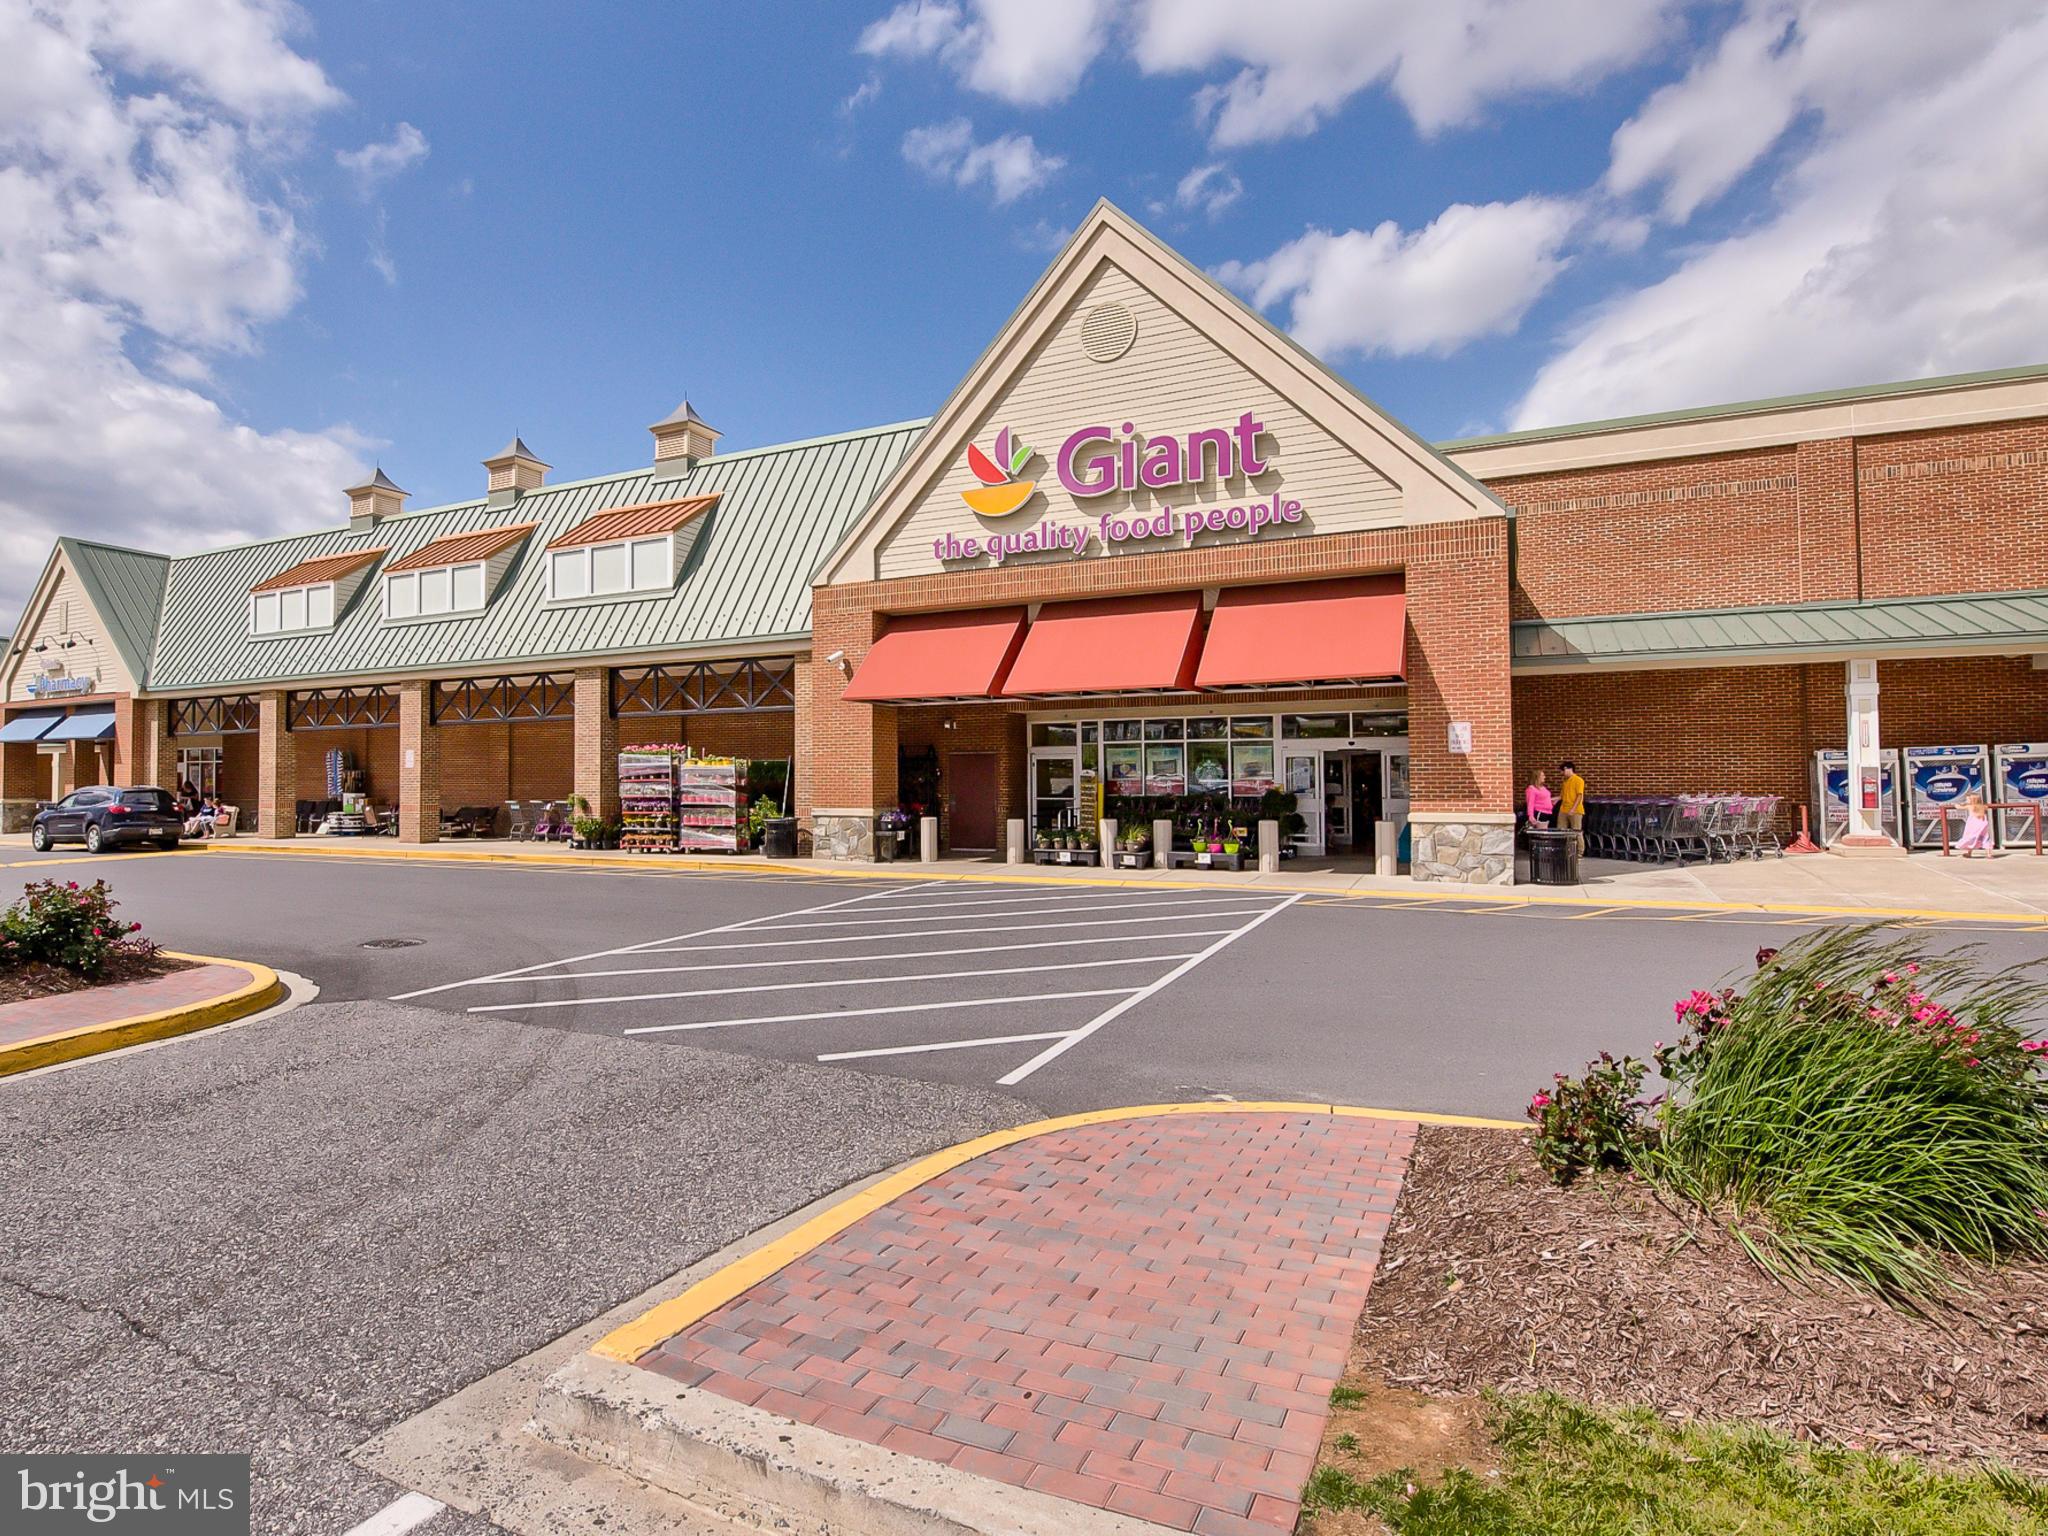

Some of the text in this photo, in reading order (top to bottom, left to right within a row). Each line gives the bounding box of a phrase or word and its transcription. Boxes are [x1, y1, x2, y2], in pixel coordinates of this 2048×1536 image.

[1056, 411, 1271, 499] Giant
[932, 492, 1303, 562] the quality food people
[39, 675, 91, 695] Pharmacy
